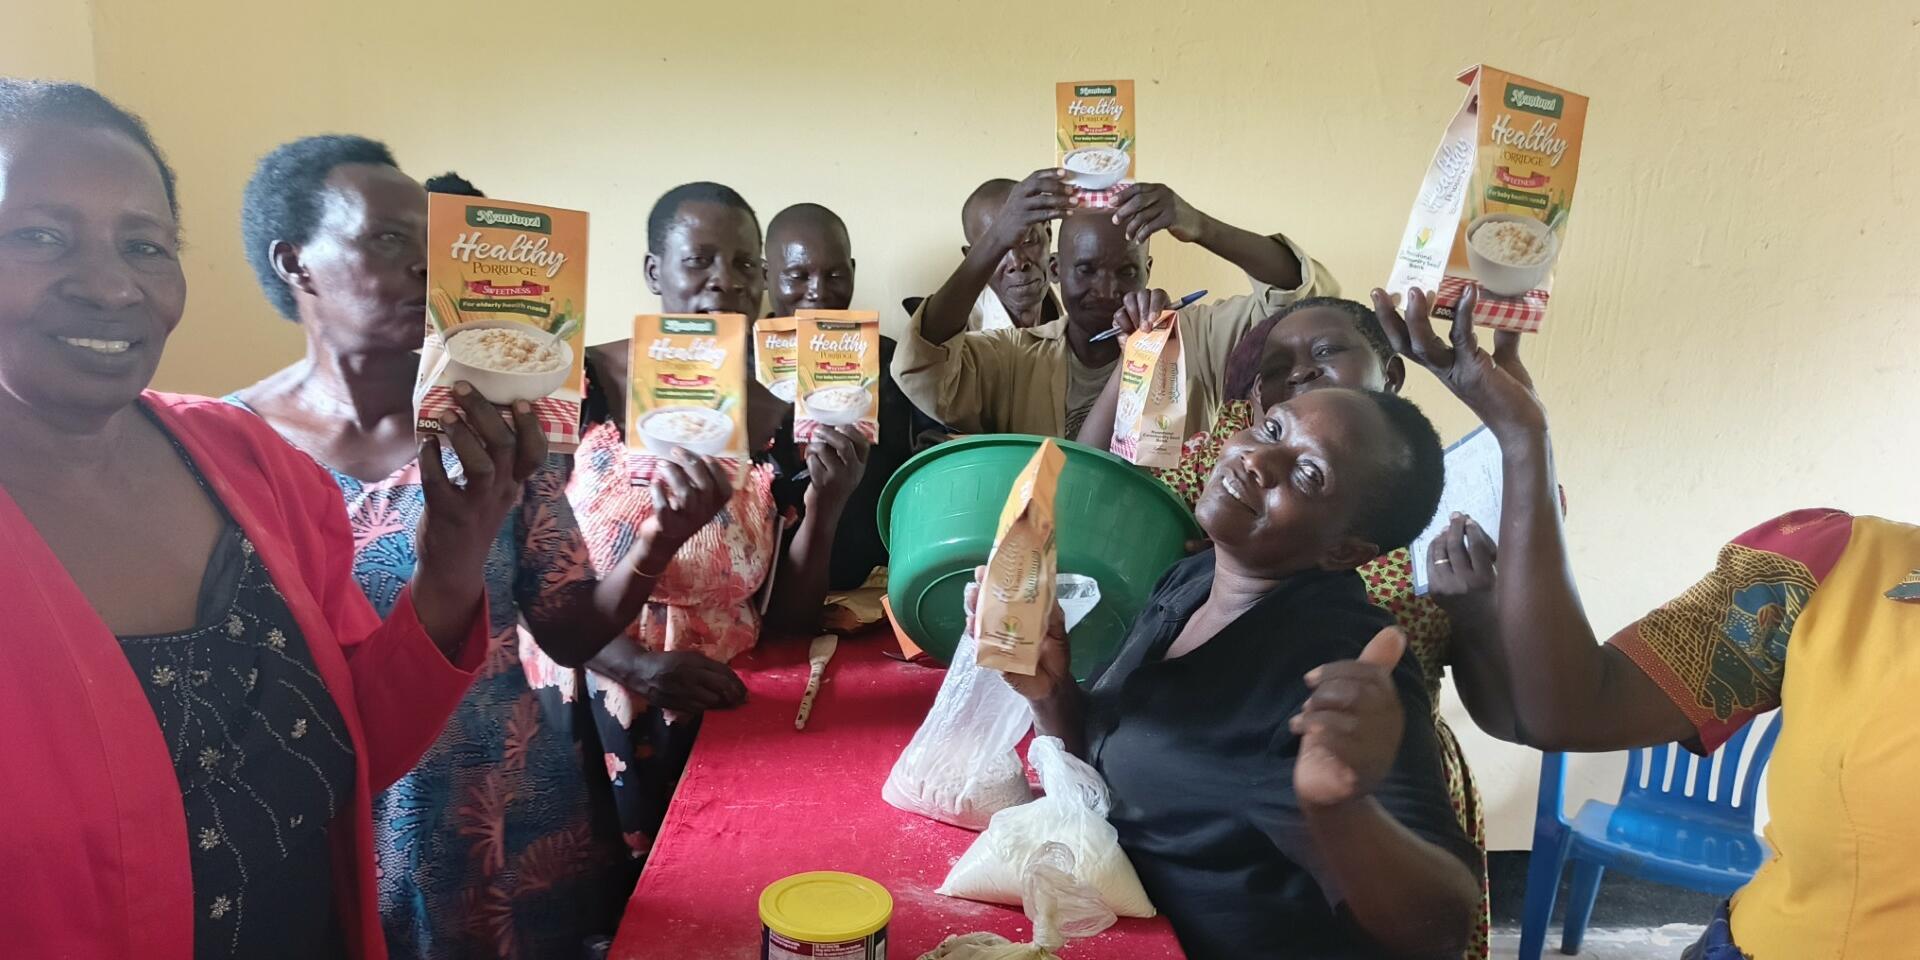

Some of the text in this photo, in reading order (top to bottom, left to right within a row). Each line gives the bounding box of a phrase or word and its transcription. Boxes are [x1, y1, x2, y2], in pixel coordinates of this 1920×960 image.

[1068, 98, 1124, 121] Healthy
[1491, 114, 1568, 167] Healthy
[451, 232, 568, 278] Healthy
[473, 262, 537, 277] PORRIDGE
[482, 286, 531, 296] SWEETNESS
[476, 302, 501, 310] elderly
[809, 331, 867, 358] Healthy
